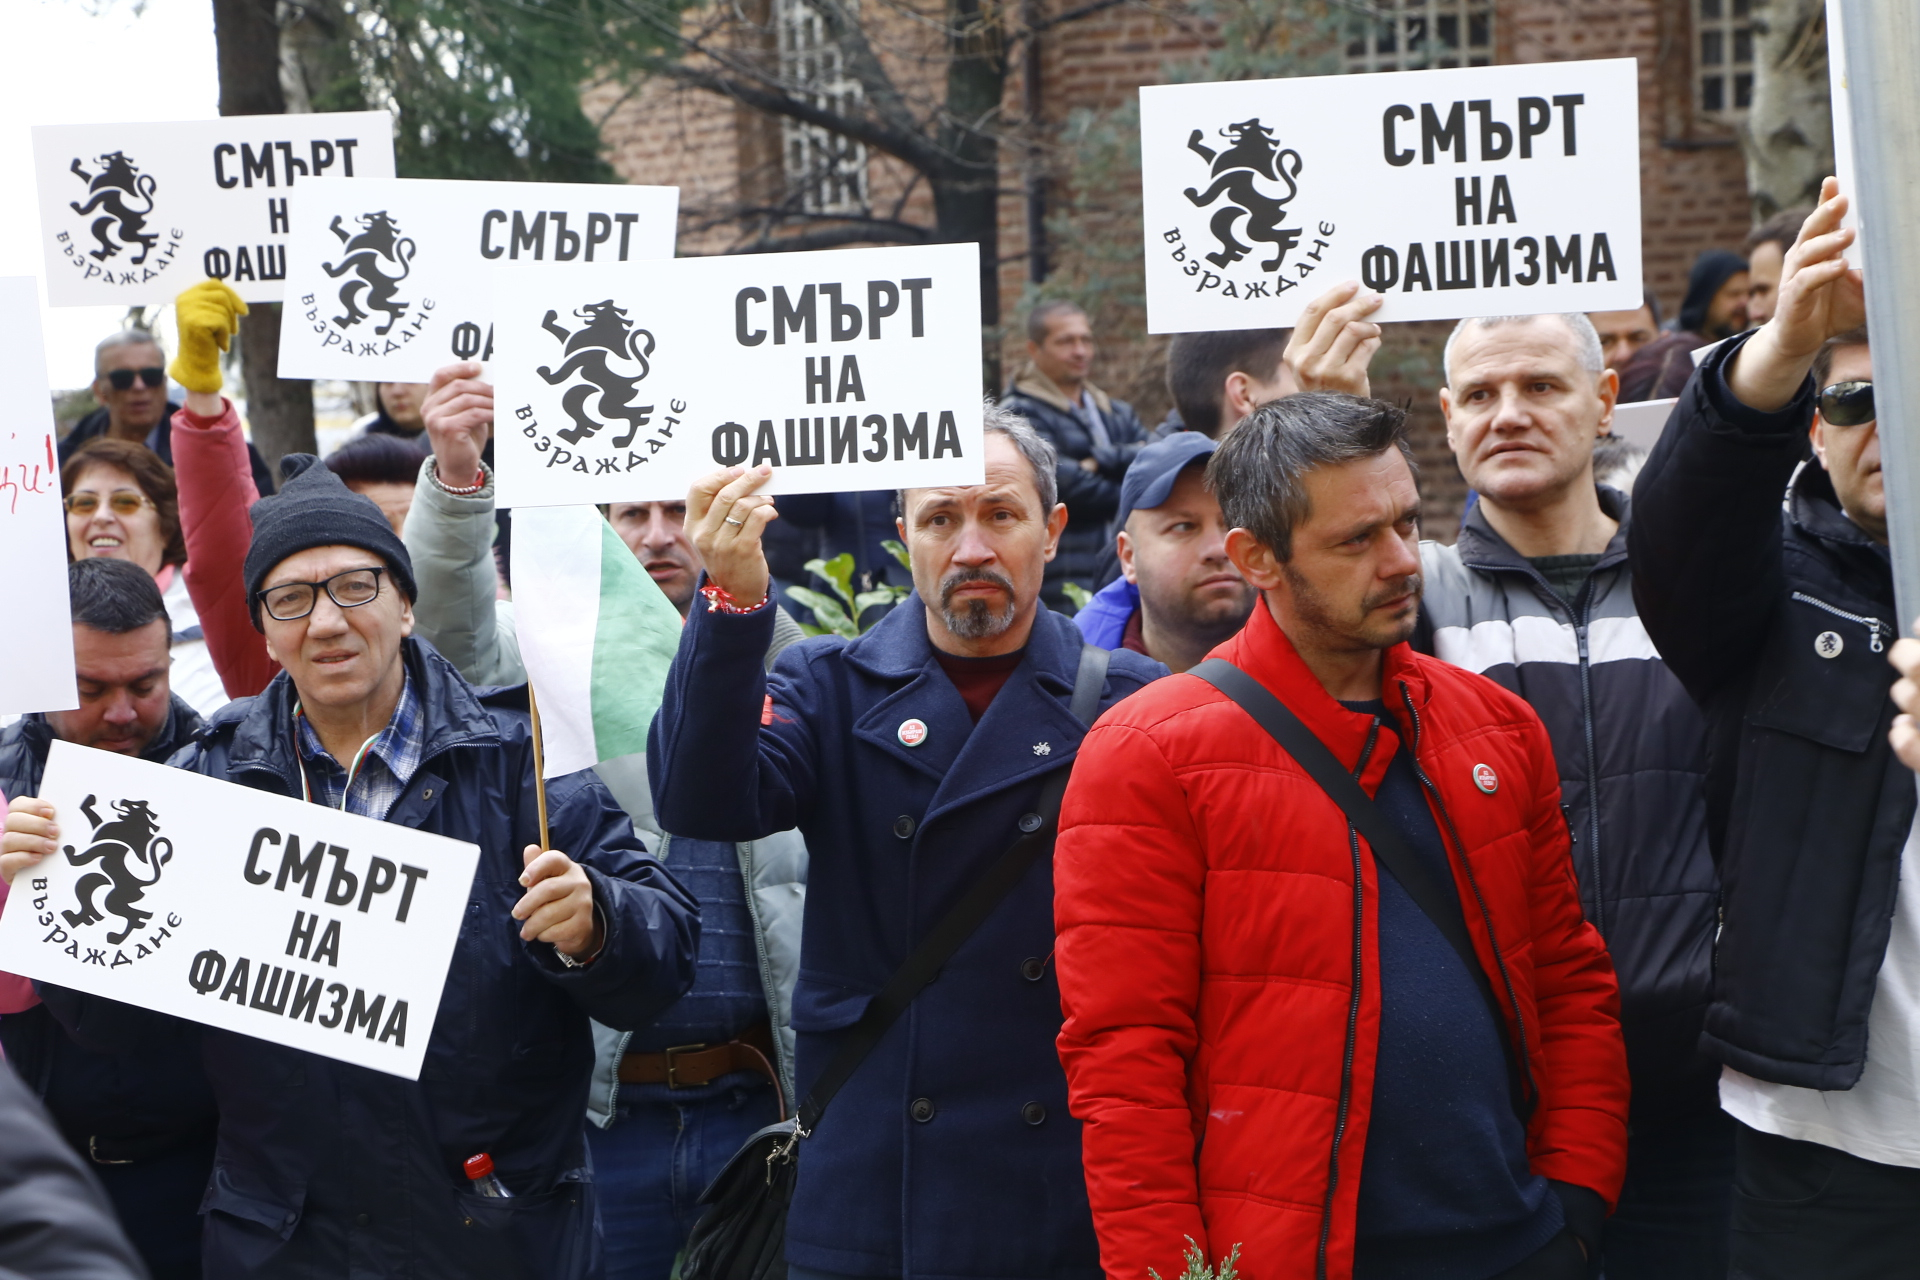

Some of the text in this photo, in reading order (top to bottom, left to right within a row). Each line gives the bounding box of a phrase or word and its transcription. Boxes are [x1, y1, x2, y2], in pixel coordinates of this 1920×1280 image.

[1382, 93, 1585, 167] СМЪРТ
[213, 138, 358, 189] СМЪРТ
[268, 197, 290, 234] Н
[1455, 174, 1518, 227] НА
[480, 209, 639, 262] СМЪРТ
[1361, 232, 1618, 294] ФАШИЗМА
[735, 277, 932, 347] СМЪРТ
[805, 354, 866, 405] НА
[711, 410, 963, 468] ФАШИЗМА
[243, 828, 429, 923] СМЪРТ
[284, 910, 342, 968] НА
[188, 948, 409, 1048] ФАШИЗМА
